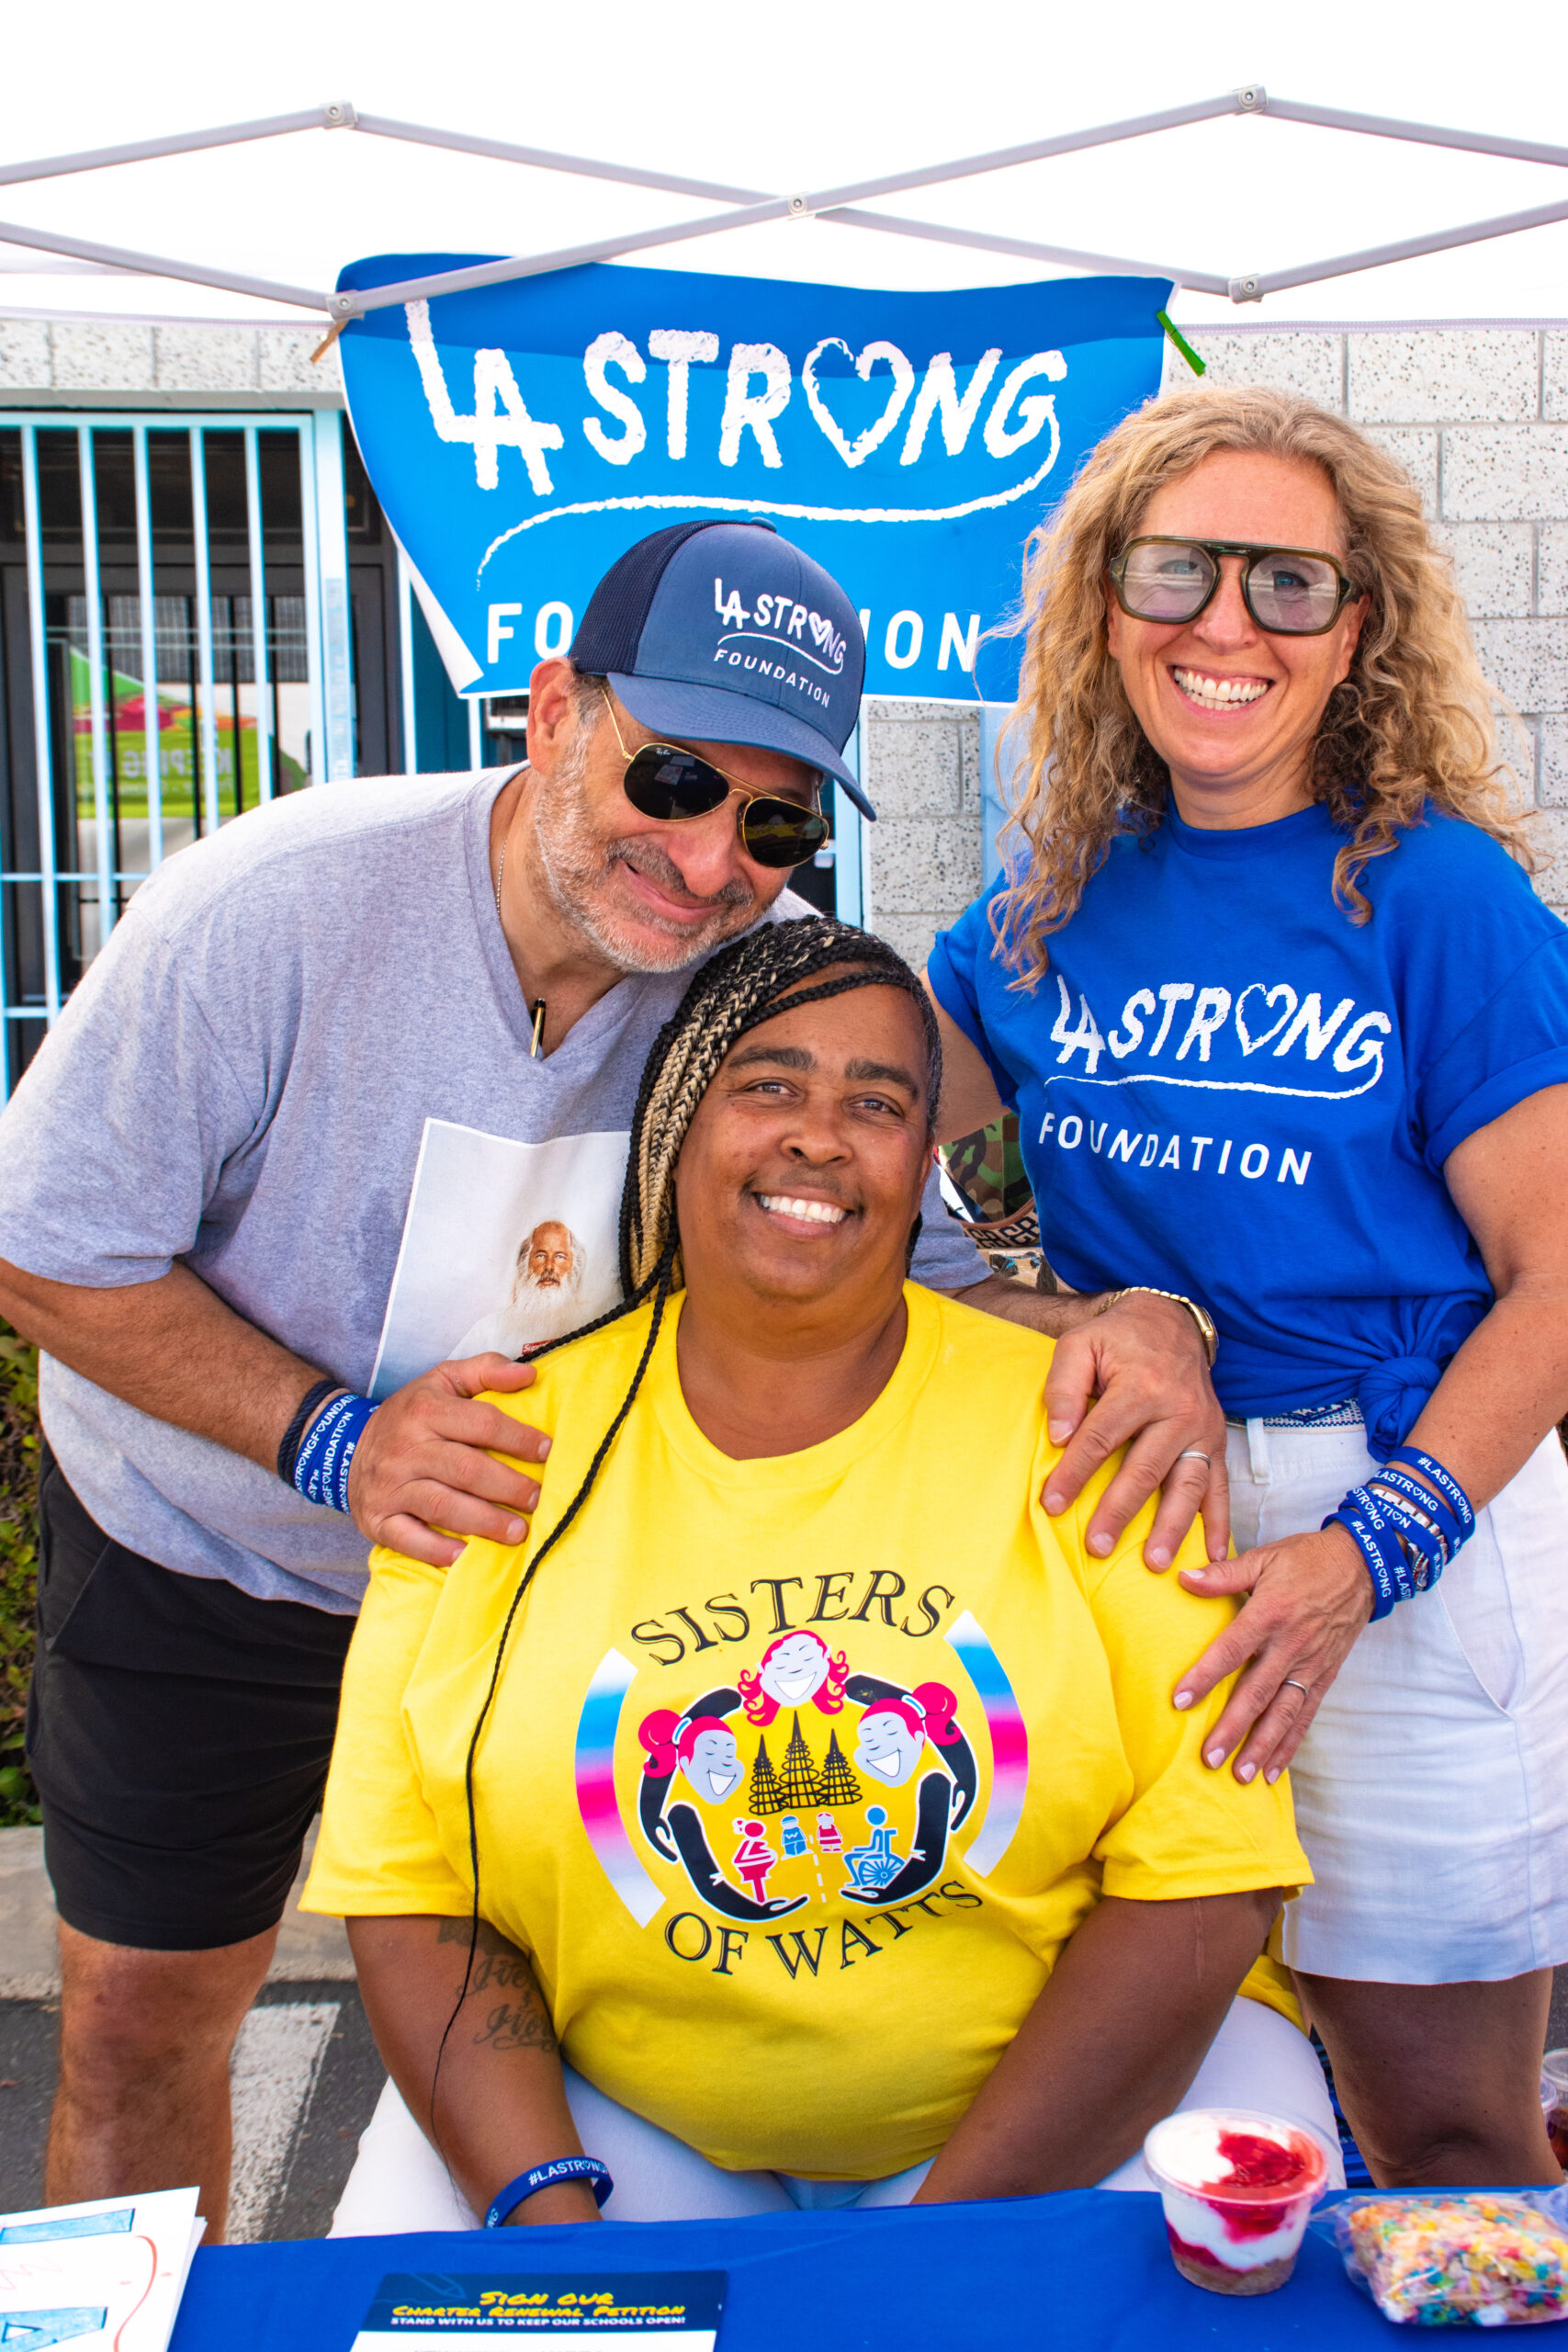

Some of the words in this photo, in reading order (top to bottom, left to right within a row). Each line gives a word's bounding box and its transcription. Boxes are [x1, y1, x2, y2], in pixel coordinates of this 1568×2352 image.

[405, 300, 564, 496] LA
[581, 329, 1067, 469] STRONG
[715, 578, 750, 629] LA
[714, 649, 830, 708] FOUNDATION
[1050, 975, 1105, 1074] LA
[1039, 1113, 1313, 1186] FOUNDATION
[631, 1570, 956, 1667] SISTERS
[664, 1912, 749, 1976] OF
[765, 1880, 984, 1980] WATTS
[390, 2317, 435, 2326] STAND
[438, 2318, 474, 2326] WITH
[476, 2318, 494, 2326] US
[497, 2318, 515, 2326] TO
[516, 2318, 550, 2326] KEEP
[551, 2318, 581, 2326] OUR
[582, 2317, 643, 2326] SCHOOLS
[645, 2316, 686, 2325] OPEN!
